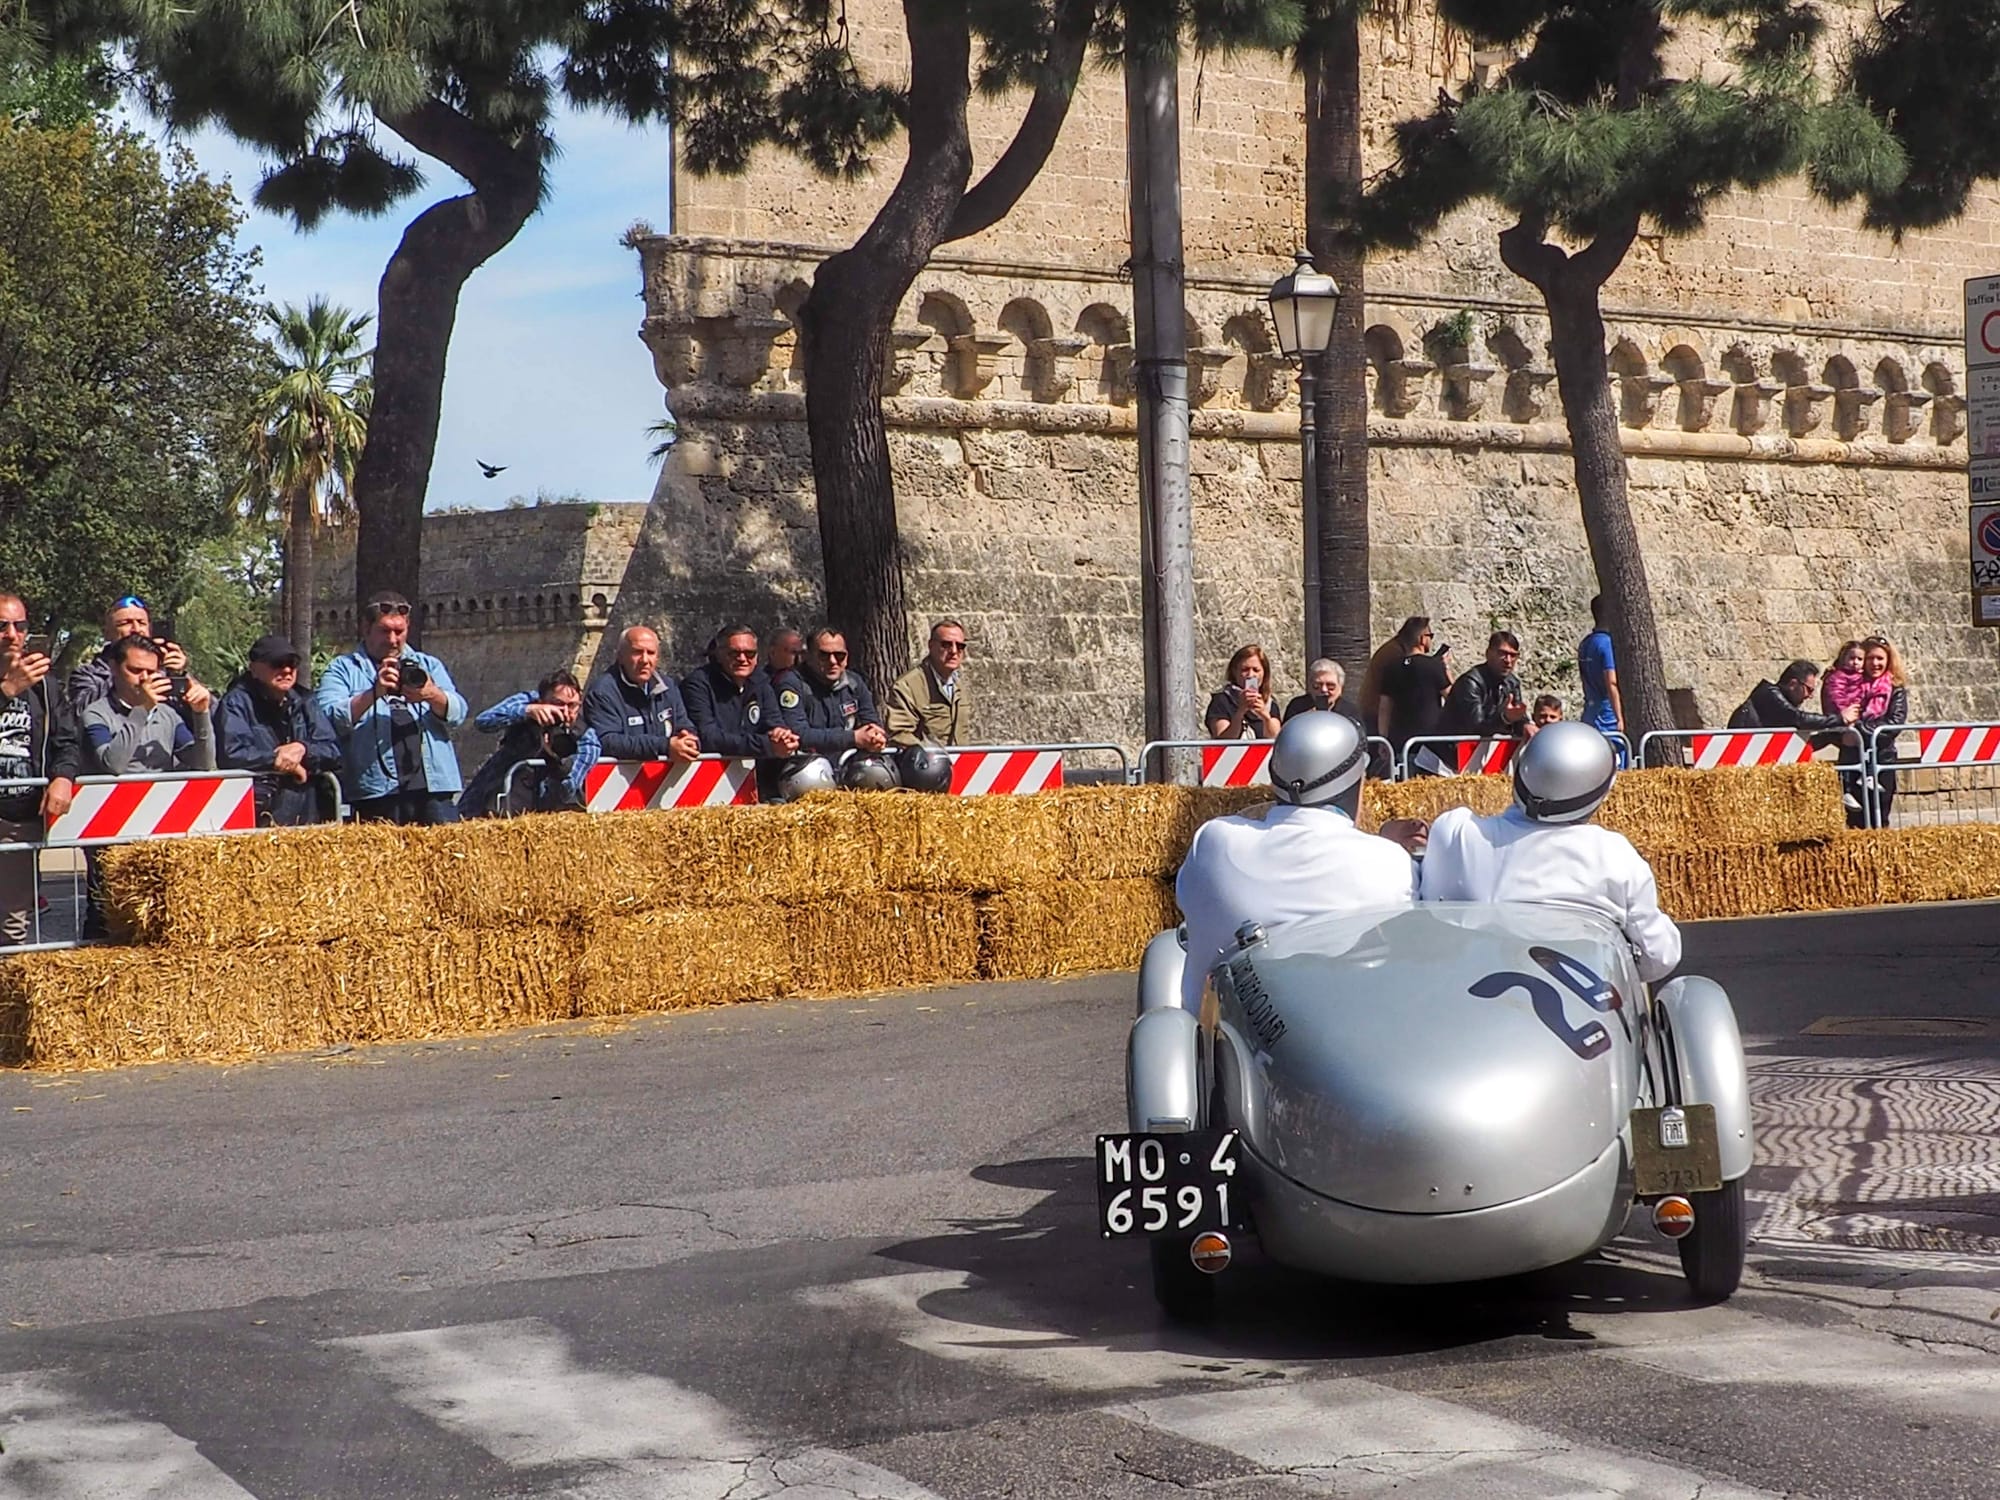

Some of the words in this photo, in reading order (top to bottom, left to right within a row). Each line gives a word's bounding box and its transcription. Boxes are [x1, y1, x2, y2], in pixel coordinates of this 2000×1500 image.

[1467, 946, 1632, 1061] 24
[1664, 1122, 1684, 1140] FIAT
[1104, 1139, 1165, 1182] MO
[1210, 1134, 1237, 1176] 4
[1657, 1168, 1704, 1189] 3731
[1107, 1182, 1229, 1233] 6591
